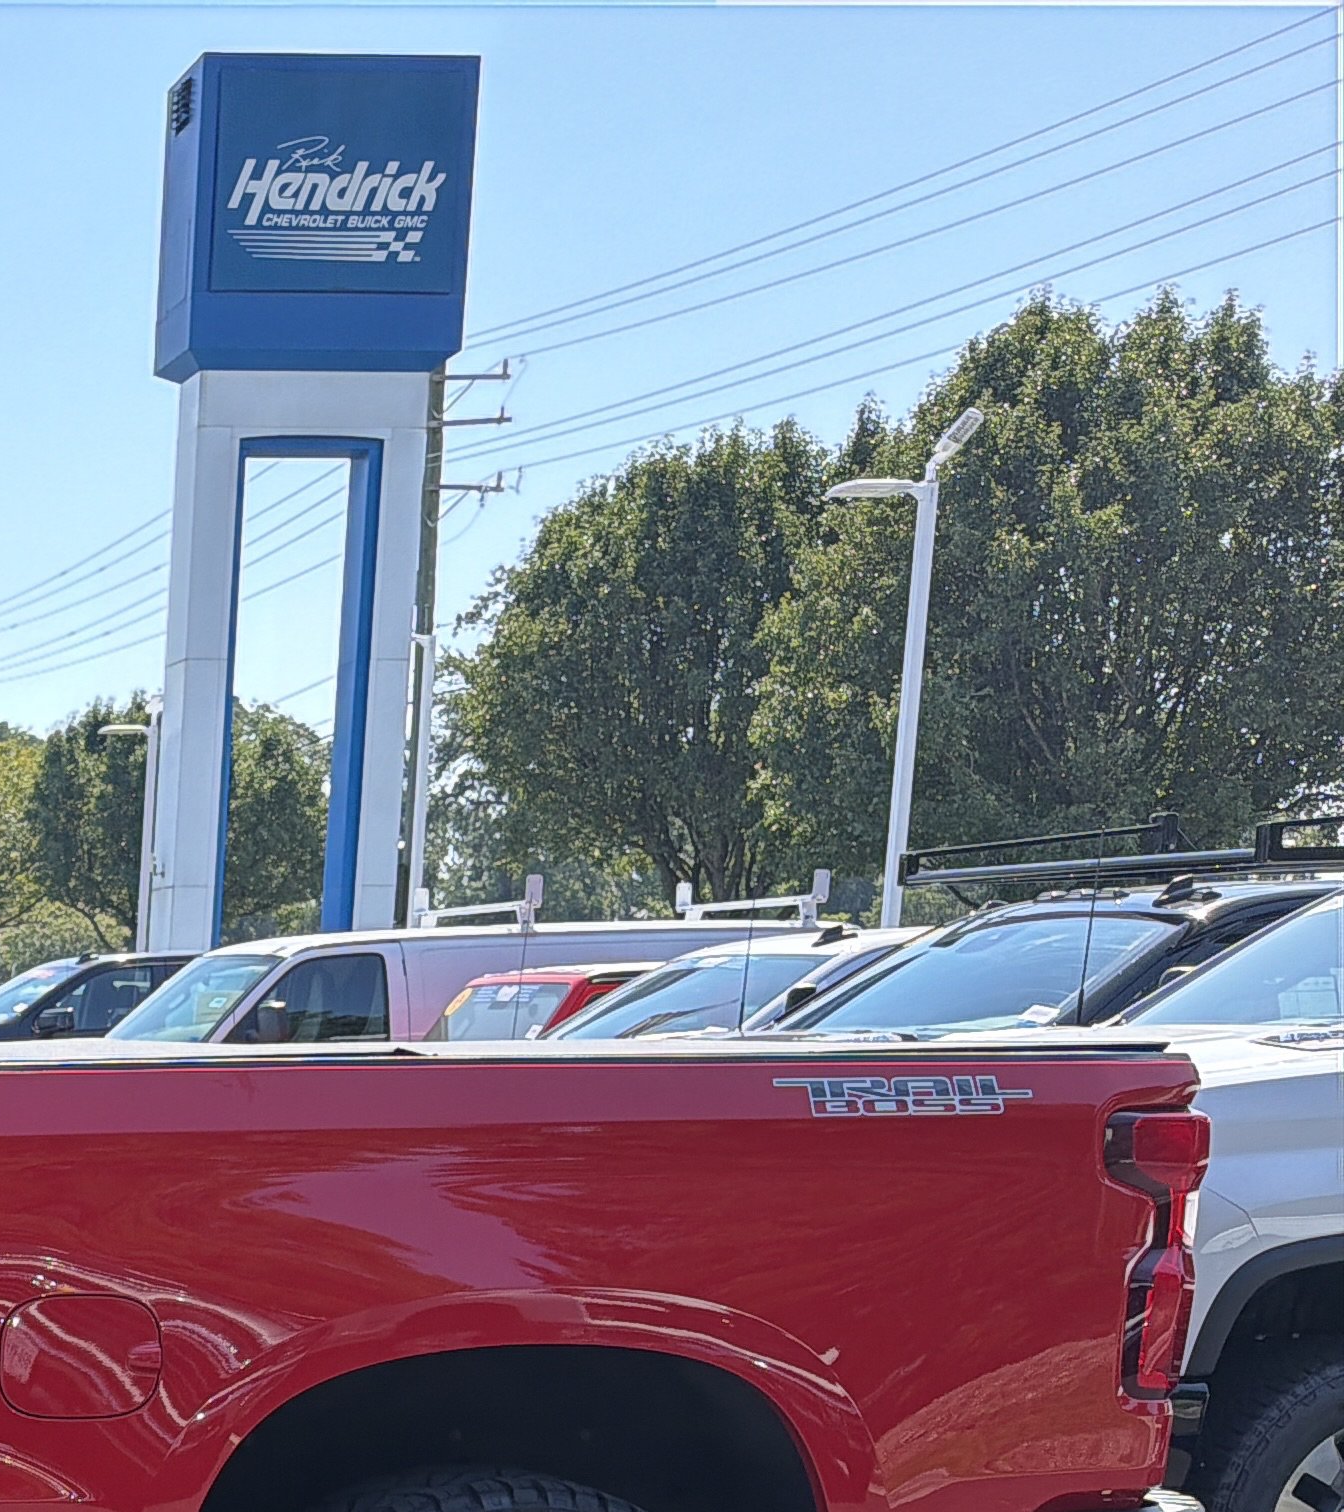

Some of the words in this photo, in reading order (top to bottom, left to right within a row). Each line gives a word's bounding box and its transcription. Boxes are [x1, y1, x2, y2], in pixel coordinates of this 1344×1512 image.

[227, 158, 447, 225] Hendrick
[262, 213, 346, 229] CHEVROLET
[347, 214, 392, 229] BUICK
[394, 215, 429, 229] GMC
[772, 1075, 1033, 1099] TRAIL
[811, 1097, 1005, 1118] BOSS
